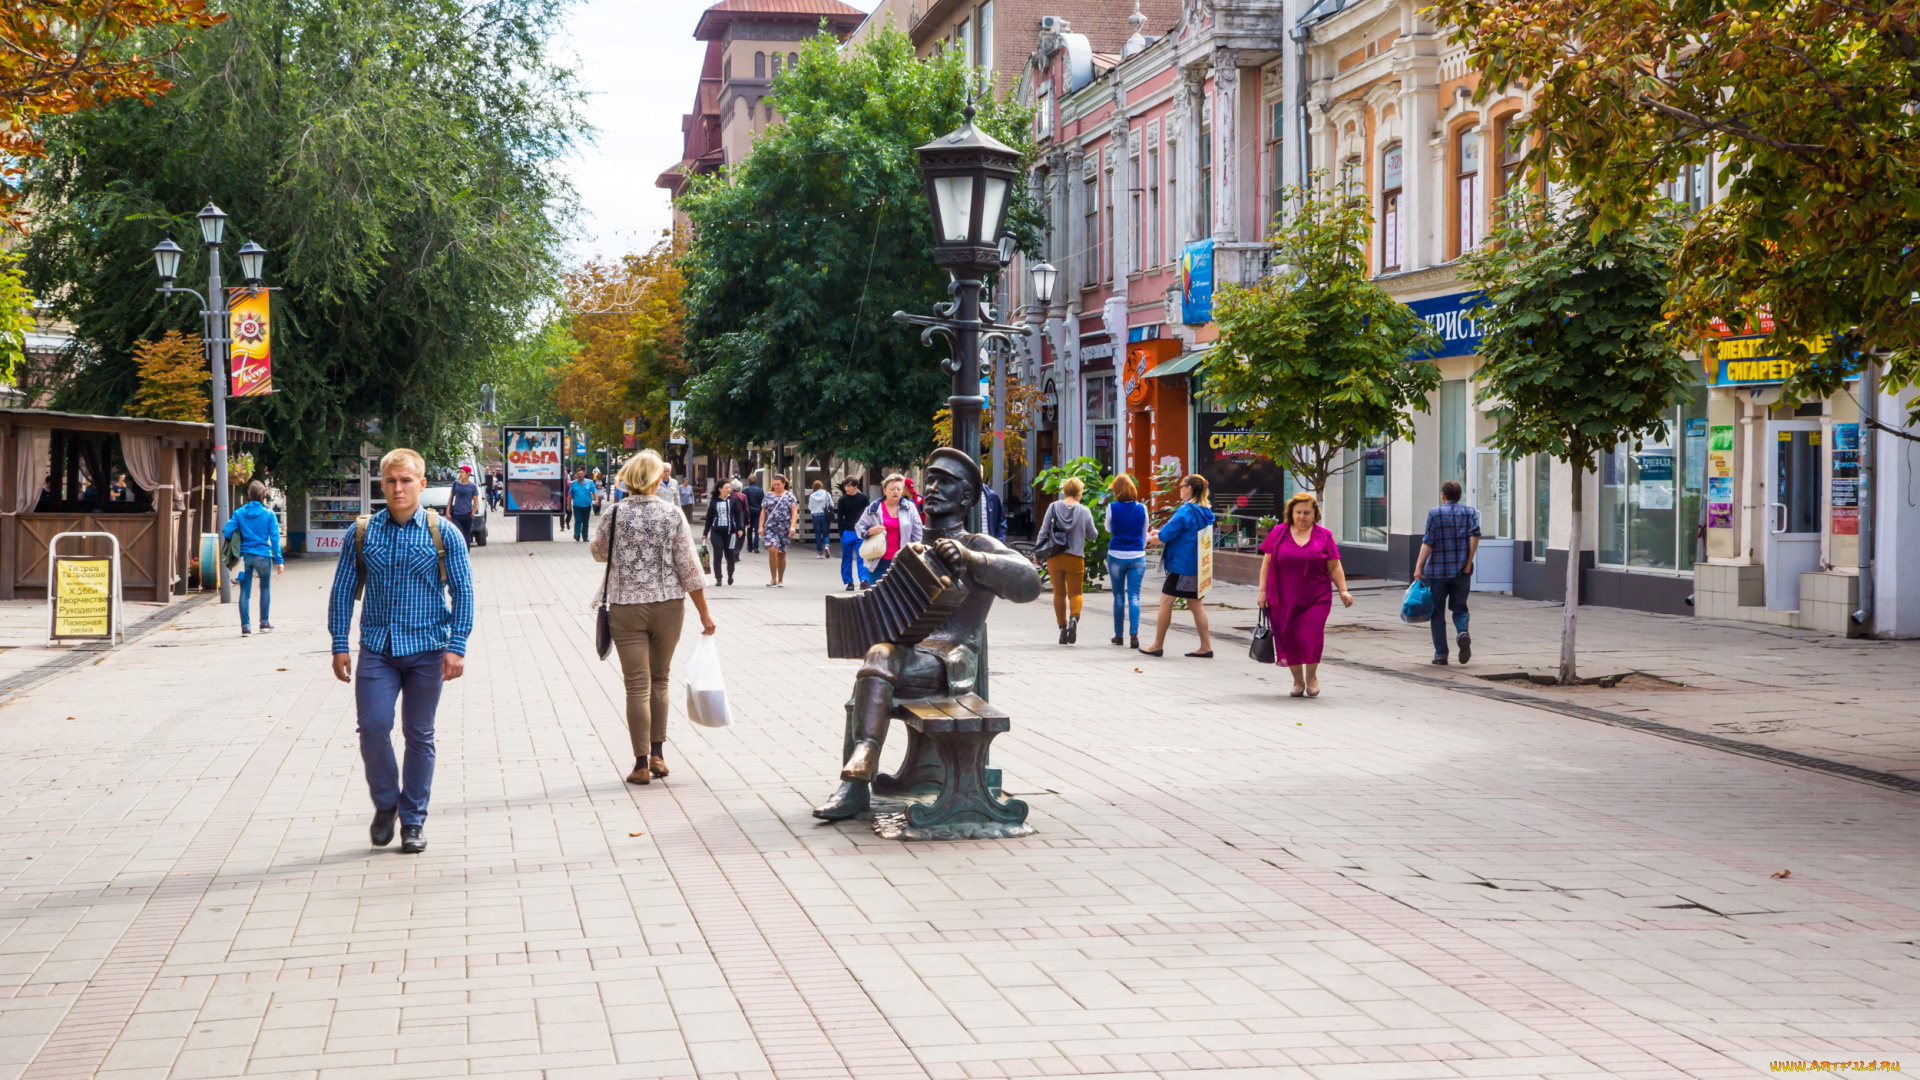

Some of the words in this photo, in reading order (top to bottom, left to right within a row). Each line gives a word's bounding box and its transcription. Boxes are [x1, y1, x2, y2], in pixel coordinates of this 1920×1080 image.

[508, 450, 559, 464] ОЛЬГА
[69, 587, 98, 595] Хобби
[58, 596, 108, 604] Творчества
[59, 606, 106, 615] Рукоделия
[62, 619, 102, 627] Лазерная
